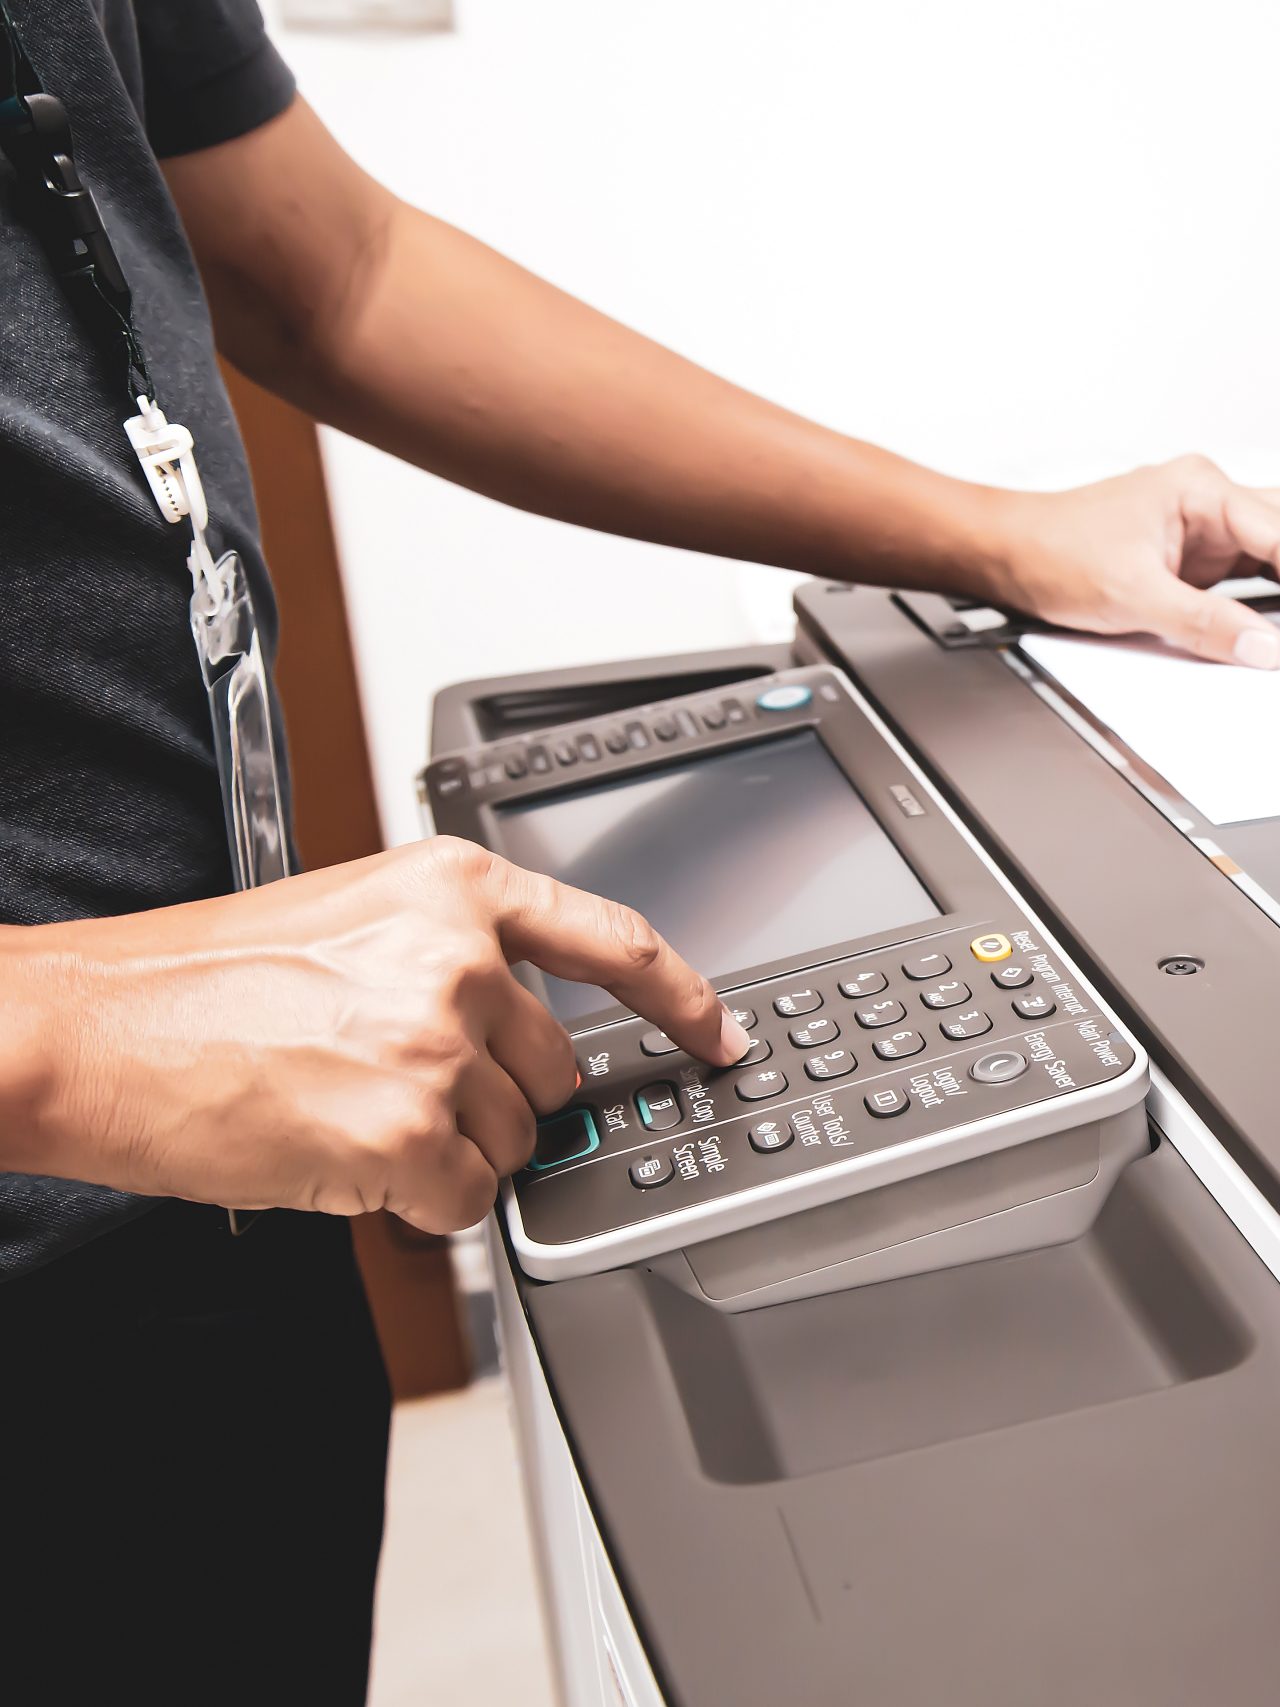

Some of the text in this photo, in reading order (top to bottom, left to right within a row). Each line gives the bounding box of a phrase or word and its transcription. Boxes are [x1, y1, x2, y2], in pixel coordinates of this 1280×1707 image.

[1010, 930, 1039, 954] Reset
[920, 954, 939, 962] 1
[856, 972, 875, 981] 4
[1029, 953, 1062, 984] Program
[792, 989, 812, 998] 7
[938, 981, 959, 992] 2
[873, 1000, 894, 1010] 5
[928, 992, 945, 1004] ABC
[1051, 983, 1089, 1016] Interrupt
[808, 1019, 828, 1030] 8
[958, 1010, 979, 1021] 3
[796, 1030, 814, 1044] TUV
[892, 1031, 913, 1041] 6
[949, 1024, 967, 1036] DEF
[878, 1040, 898, 1056] MNO
[1074, 1019, 1124, 1068] Main Power
[588, 1052, 610, 1076] Stop
[824, 1050, 845, 1060] 9
[1024, 1031, 1076, 1089] Energy Saver
[809, 1056, 830, 1075] WXYZ
[757, 1071, 778, 1082] #
[932, 1066, 968, 1097] Login/
[909, 1072, 945, 1109] Logout
[603, 1104, 629, 1132] Start
[692, 1099, 716, 1122] Copy
[791, 1110, 822, 1148] Counter
[811, 1094, 854, 1148] User Tools/
[673, 1143, 700, 1181] Screen
[698, 1136, 729, 1174] Simple
